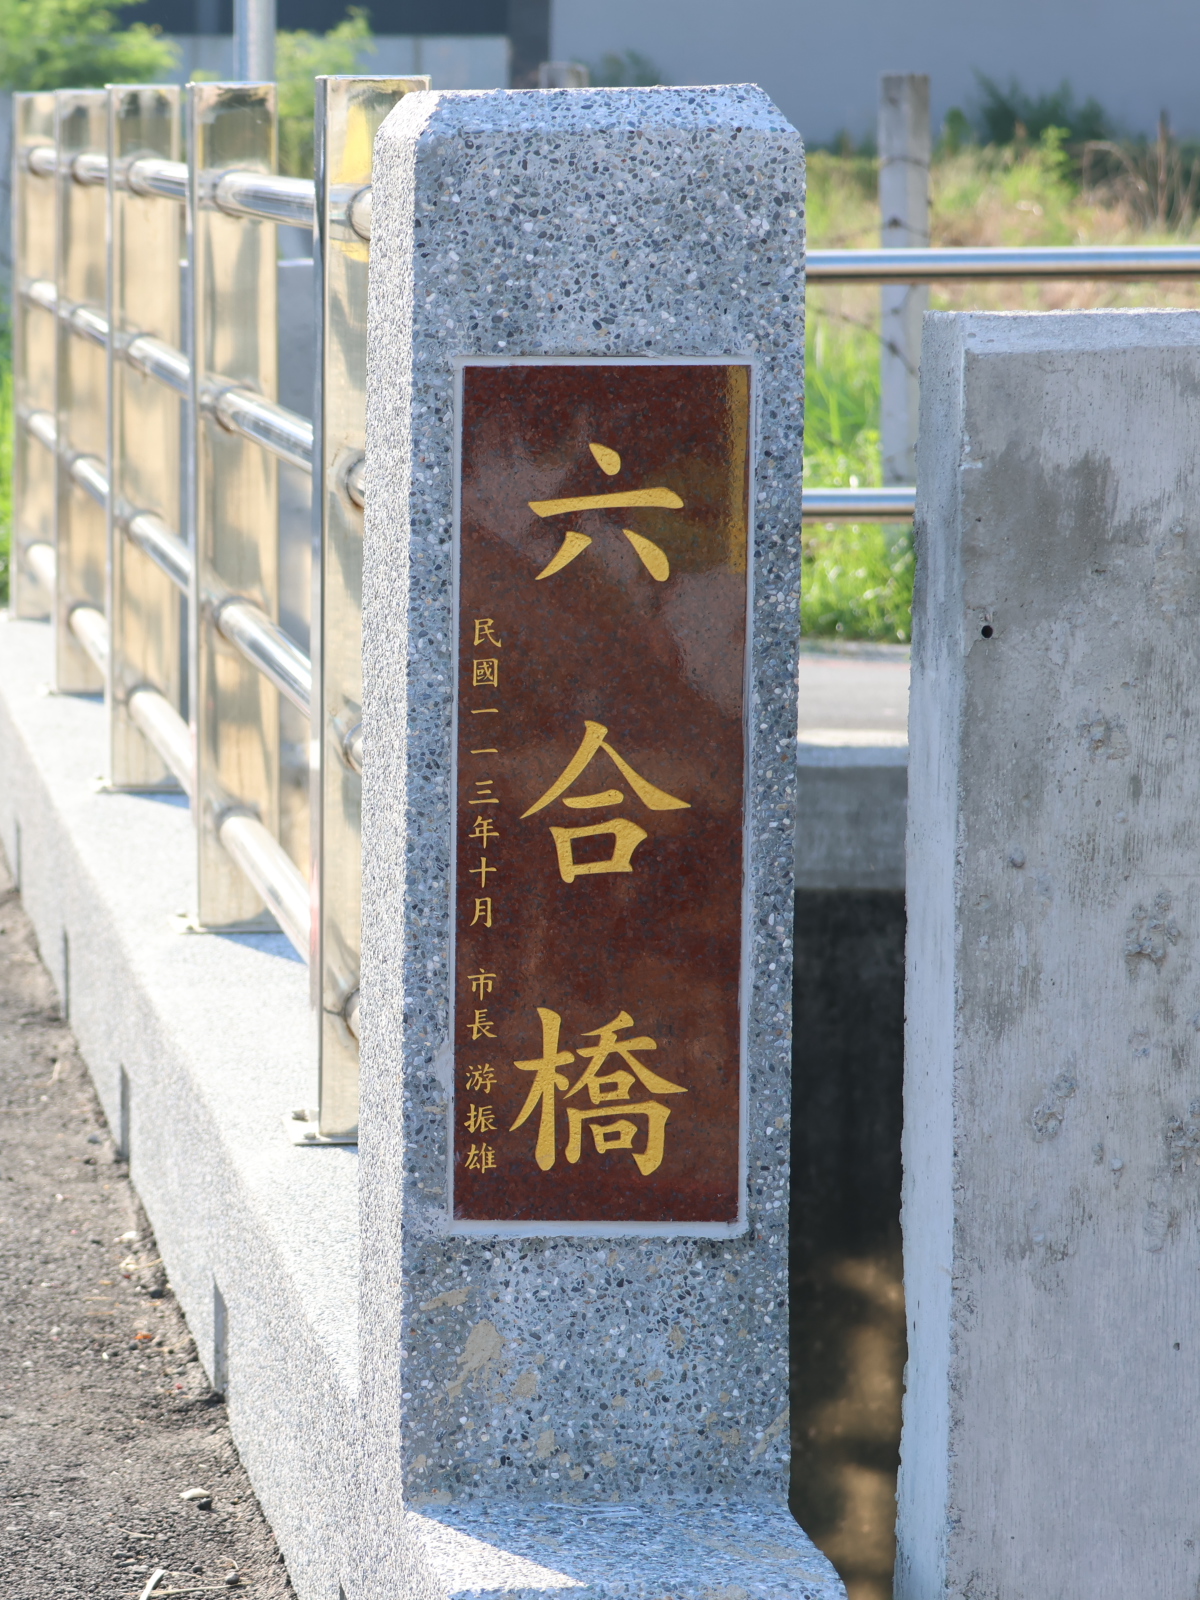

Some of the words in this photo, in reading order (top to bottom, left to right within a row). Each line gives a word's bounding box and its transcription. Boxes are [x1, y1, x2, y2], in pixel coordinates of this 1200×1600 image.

[468, 618, 502, 928] 民國一一三年十月
[509, 443, 691, 1176] 六合橋
[466, 968, 497, 1040] 市長
[464, 1064, 498, 1174] 游振雄
